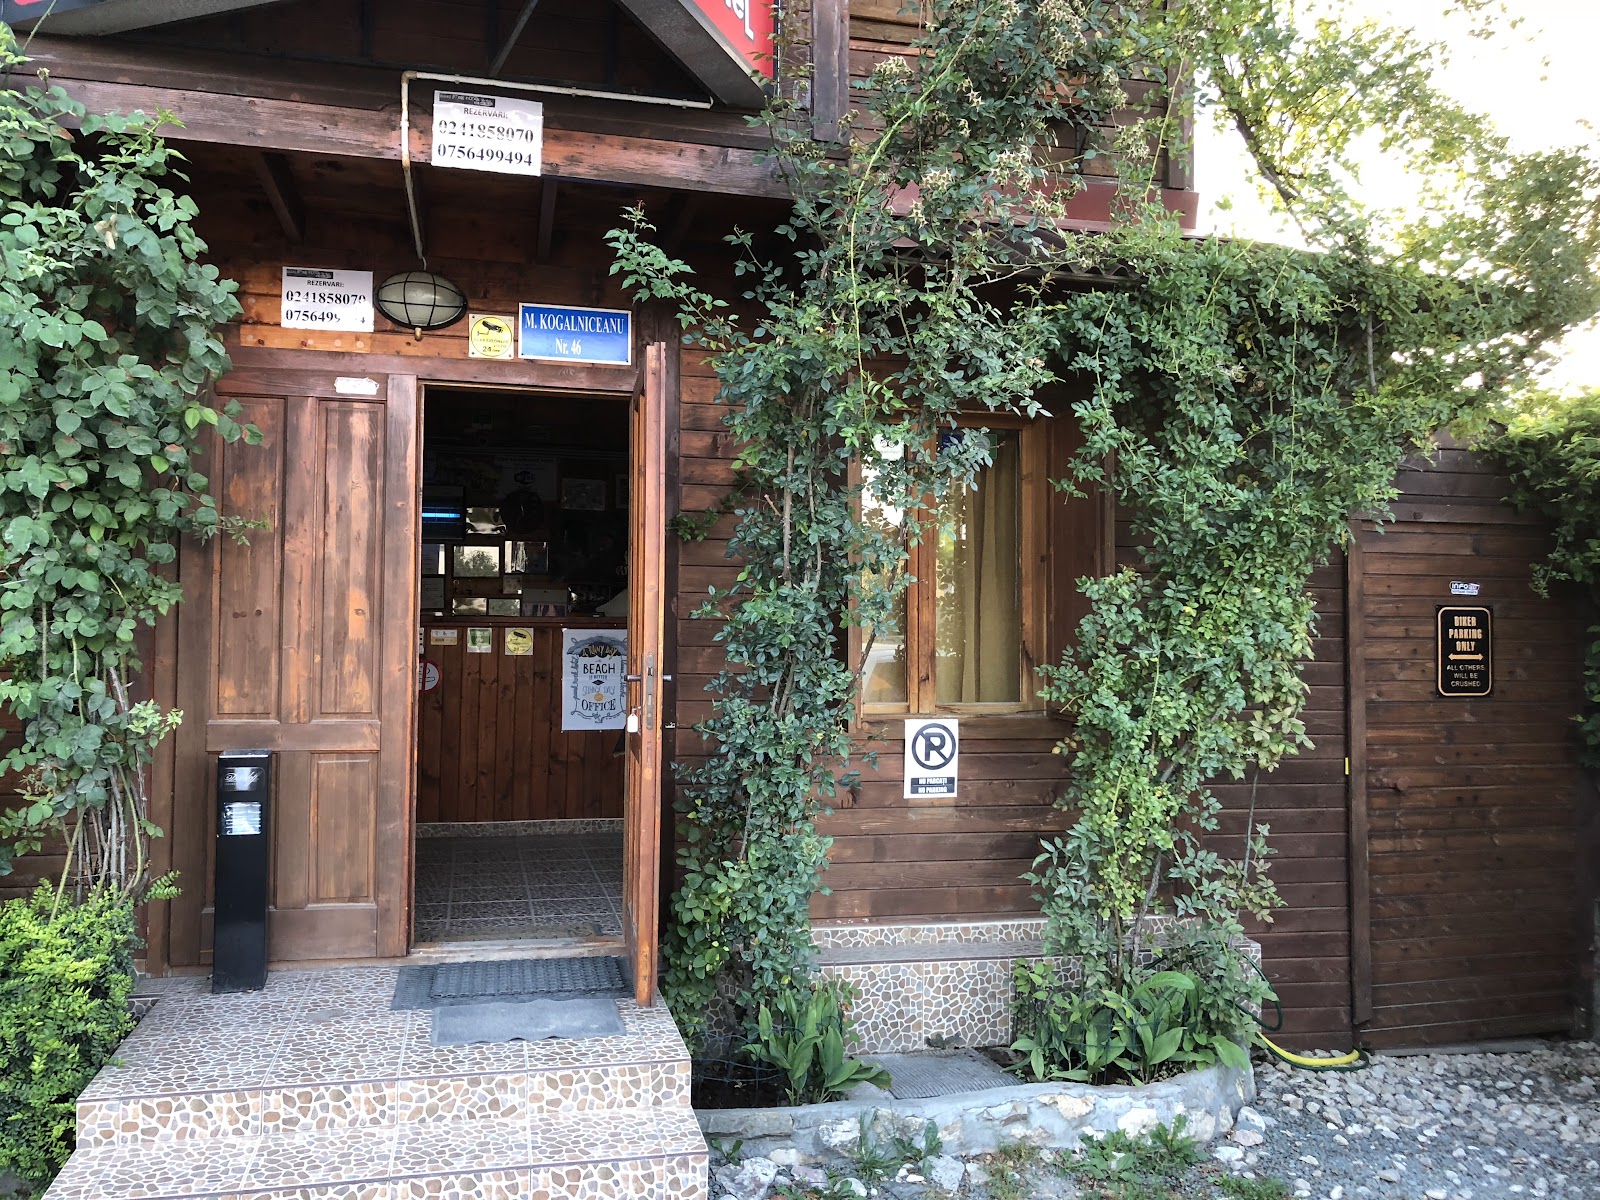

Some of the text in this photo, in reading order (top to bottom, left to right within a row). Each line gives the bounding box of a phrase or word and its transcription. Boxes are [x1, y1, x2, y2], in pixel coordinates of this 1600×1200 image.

[725, 0, 754, 40] el
[438, 144, 532, 166] 0756499494
[525, 312, 624, 334] M. KOGALNICEANU
[555, 338, 582, 355] Nr. 46
[1454, 616, 1476, 626] BIKER
[1449, 629, 1482, 639] PARKING
[1456, 641, 1475, 651] ONLY
[583, 663, 615, 674] BEACH
[582, 699, 616, 711] OFFICE
